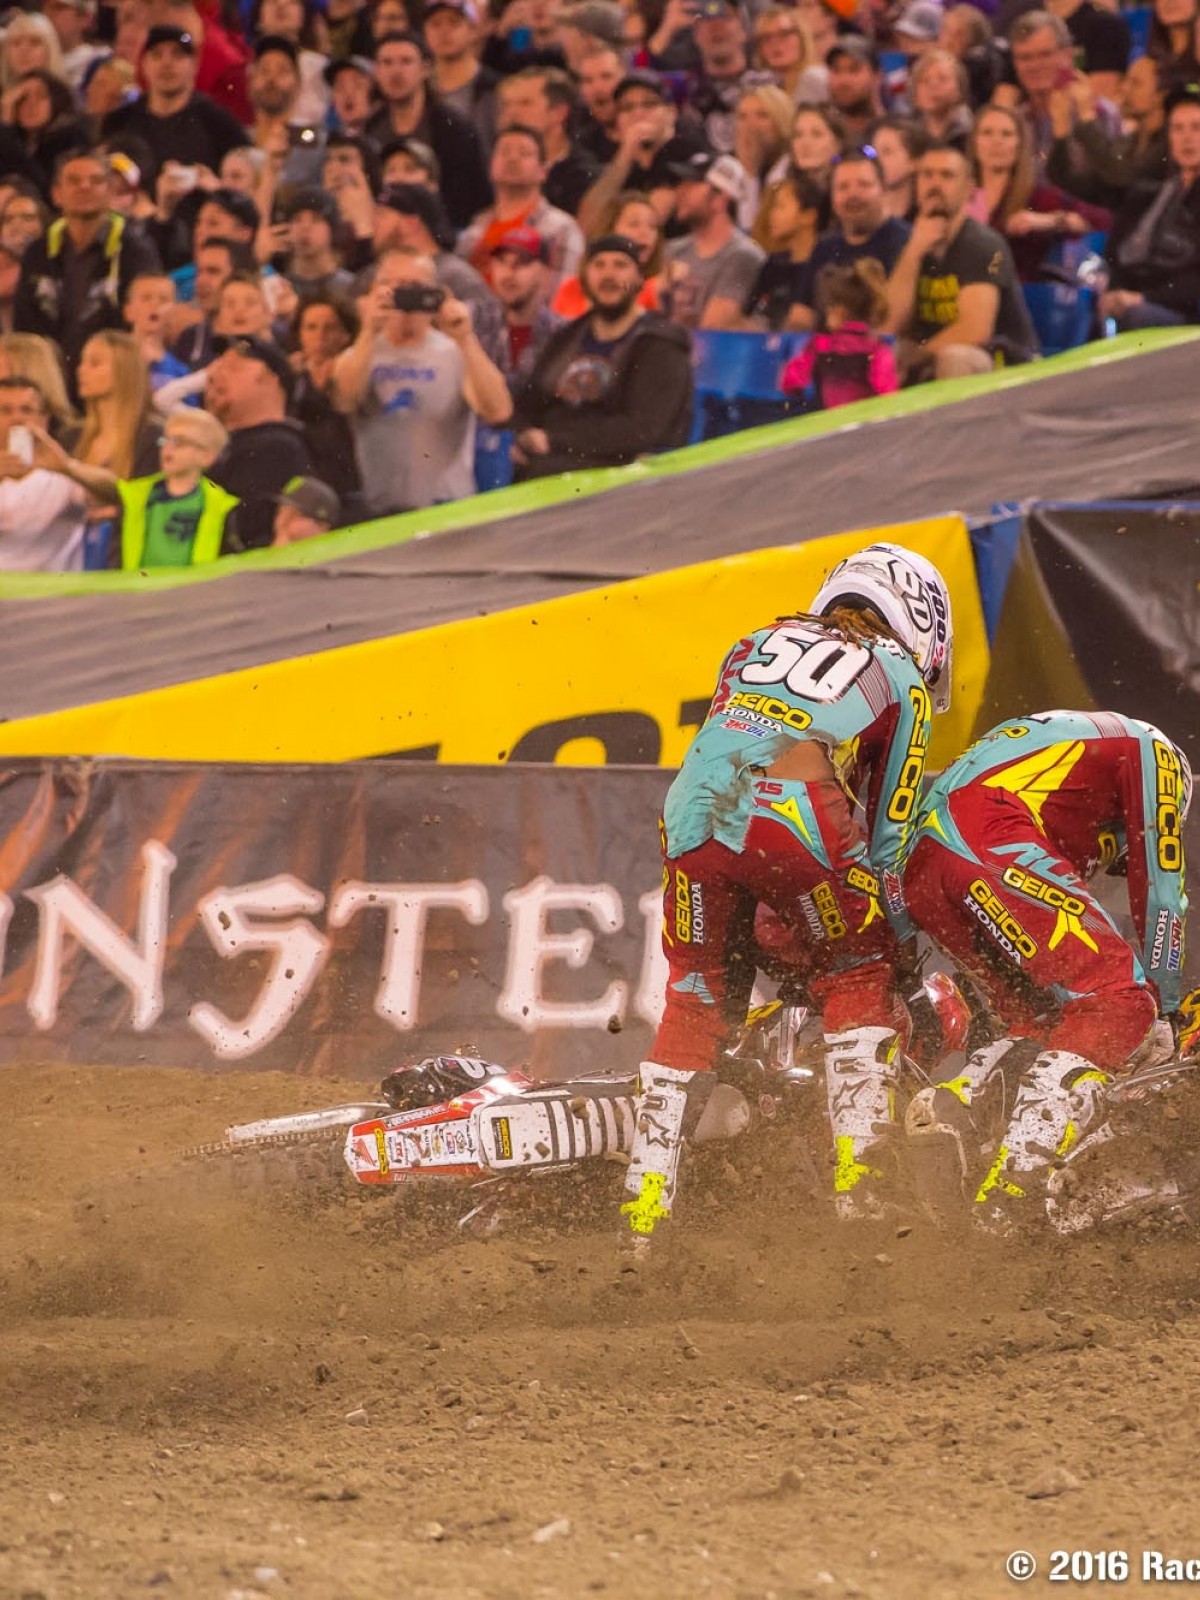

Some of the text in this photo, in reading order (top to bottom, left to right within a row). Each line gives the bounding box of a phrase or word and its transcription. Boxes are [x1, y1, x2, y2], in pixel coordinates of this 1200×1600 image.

[740, 626, 872, 706] 50
[721, 707, 783, 733] HONDA
[726, 693, 812, 731] GEICO
[1154, 740, 1182, 872] GEICO
[675, 869, 692, 943] GEICO
[812, 883, 846, 939] GEICO
[847, 868, 881, 896] GEICO
[1002, 866, 1086, 917] GEICO
[692, 882, 704, 944] HONDA
[800, 893, 826, 940] HONDA
[963, 894, 1021, 964] HONDA
[969, 879, 1038, 959] GEICO
[1151, 909, 1169, 970] HONDA
